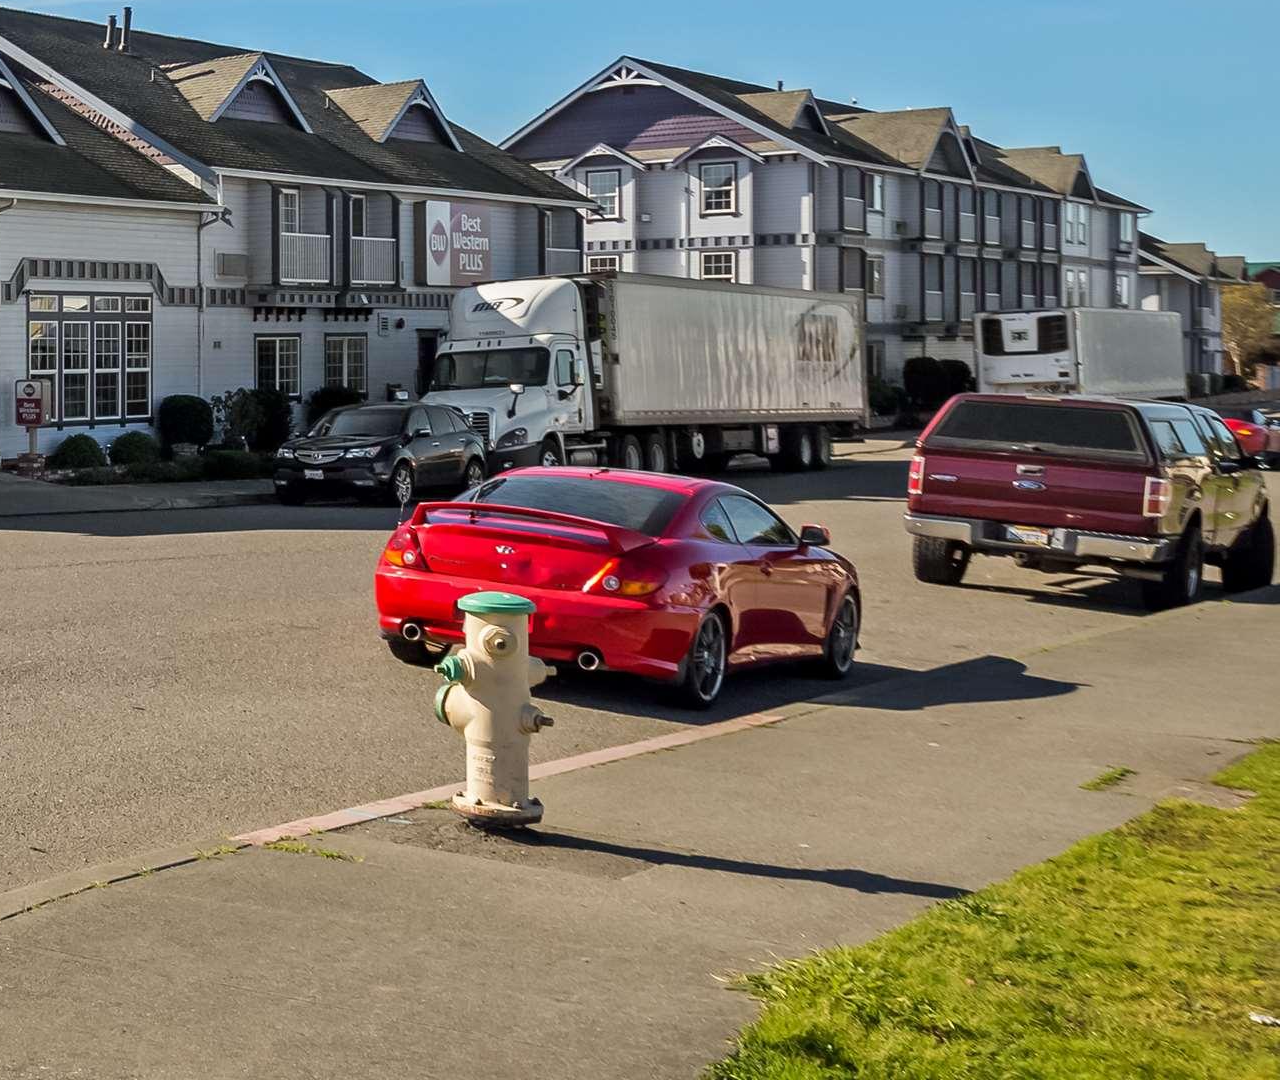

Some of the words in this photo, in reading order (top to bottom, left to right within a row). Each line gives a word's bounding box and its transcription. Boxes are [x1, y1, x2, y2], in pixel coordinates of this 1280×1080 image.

[461, 214, 482, 232] Best
[431, 234, 447, 251] BW
[452, 232, 489, 251] Western
[459, 253, 483, 271] PLUS
